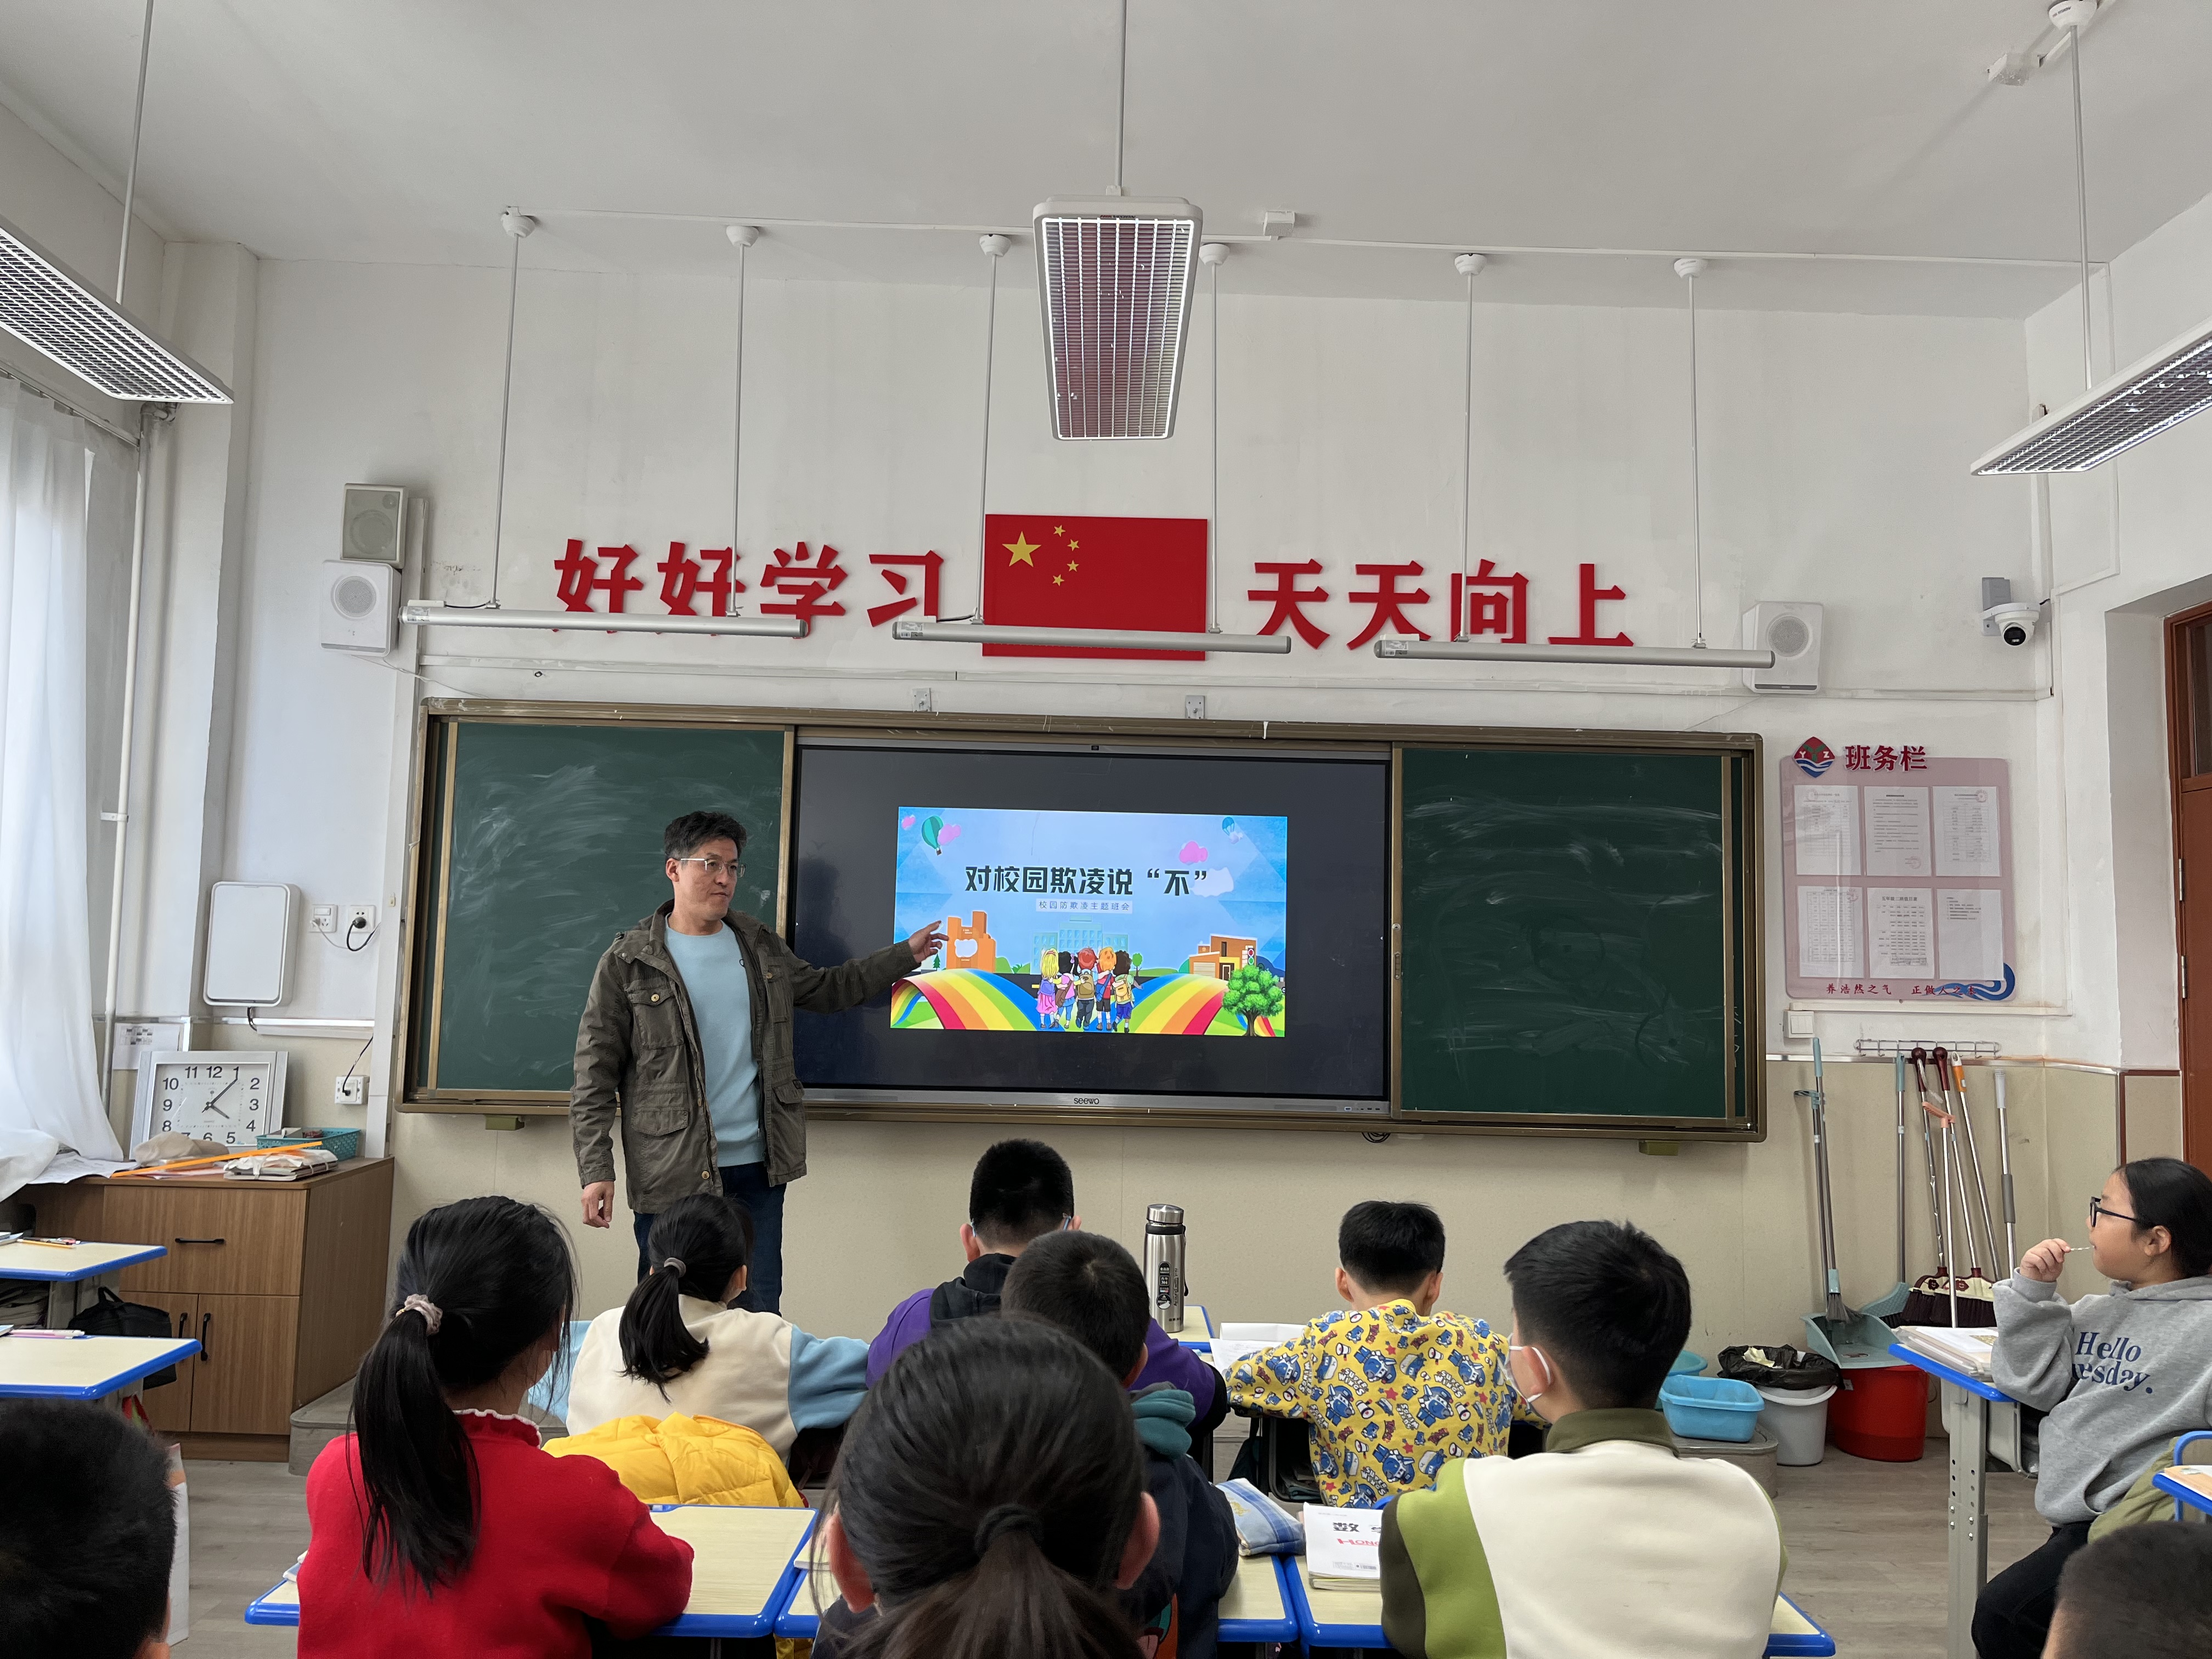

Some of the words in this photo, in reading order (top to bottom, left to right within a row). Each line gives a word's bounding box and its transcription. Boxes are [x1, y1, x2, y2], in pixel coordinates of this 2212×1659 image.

[554, 538, 944, 638] 好好学习
[1247, 558, 1634, 650] 天天向上
[1845, 744, 1928, 771] 班务栏
[1039, 900, 1130, 911] 校园防欺凌主题班会
[1826, 983, 1892, 995] 养浩然之气
[185, 1066, 198, 1079] 11
[206, 1066, 222, 1078] 12
[162, 1077, 179, 1090] 10
[250, 1077, 260, 1090] 2
[163, 1099, 172, 1111] 9
[249, 1098, 259, 1111] 3
[162, 1120, 172, 1132] 8
[246, 1120, 256, 1132] 4
[226, 1132, 236, 1144] 5
[2075, 1331, 2141, 1362] Hello
